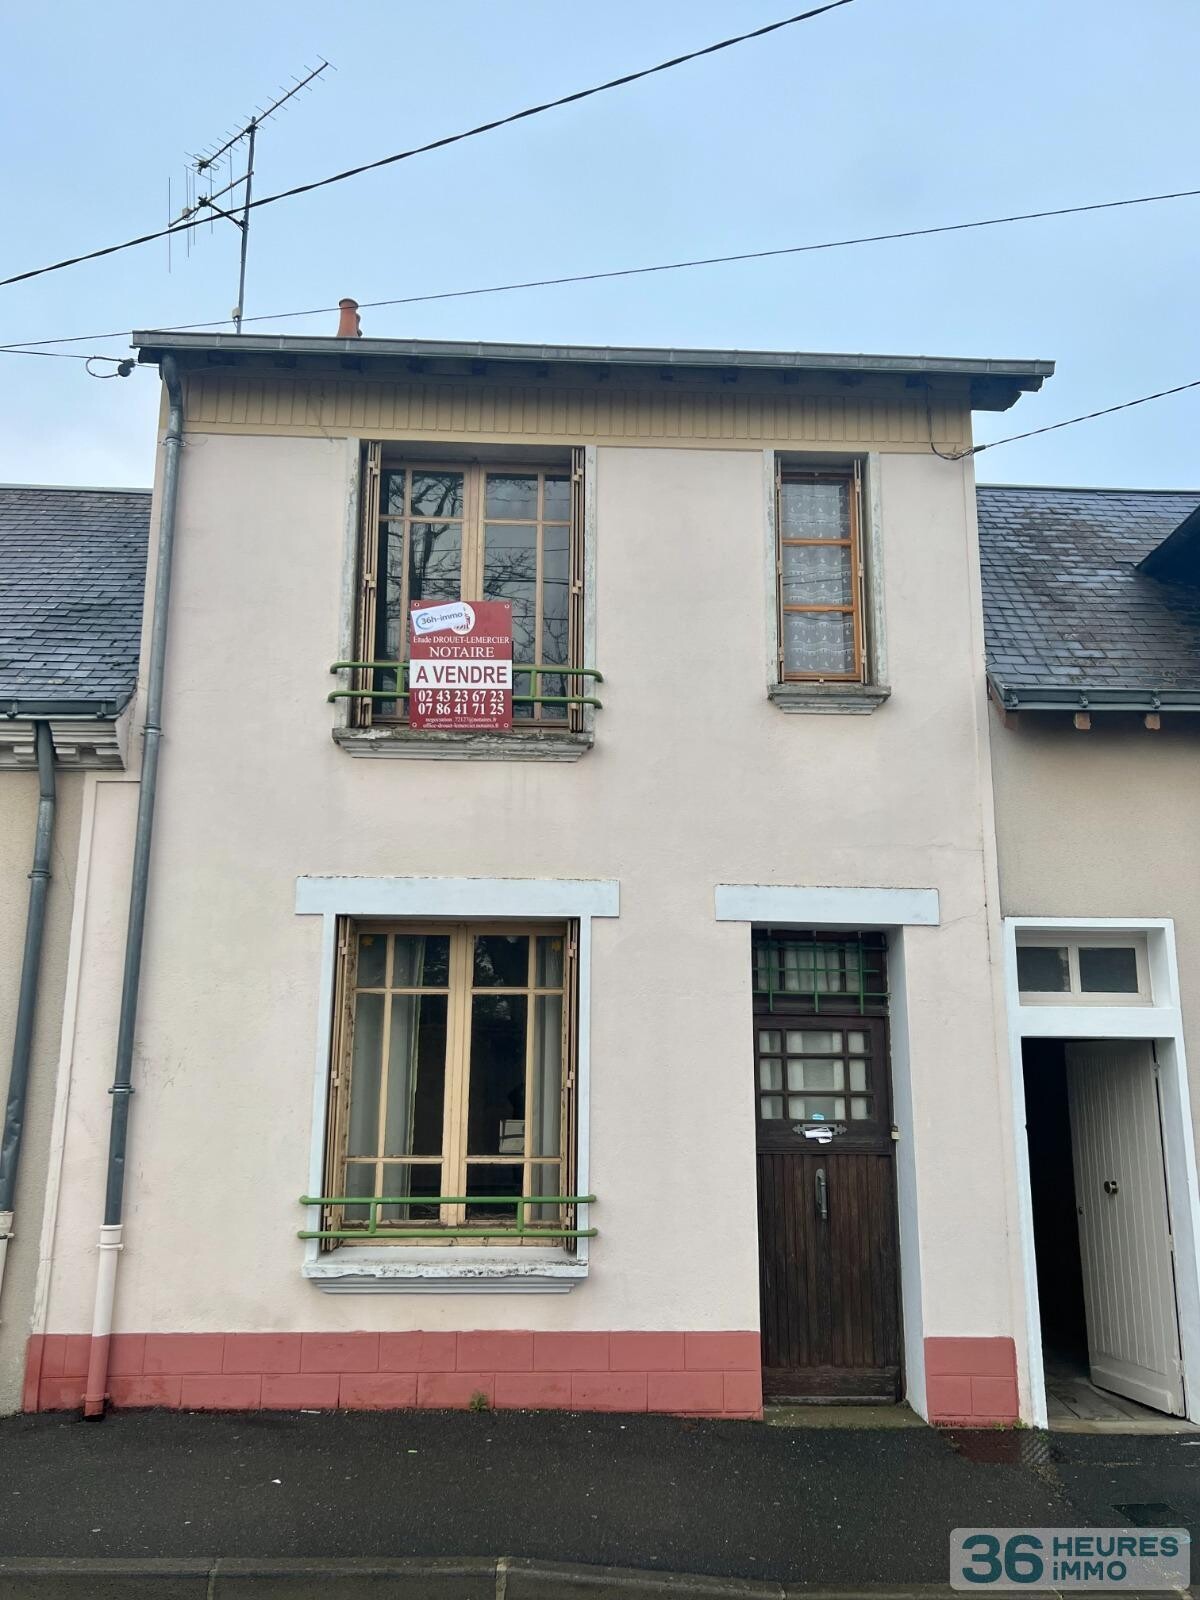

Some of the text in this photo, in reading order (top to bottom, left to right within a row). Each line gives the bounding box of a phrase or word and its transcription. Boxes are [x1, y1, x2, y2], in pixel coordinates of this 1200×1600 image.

[421, 611, 463, 625] 36h-immo
[433, 636, 510, 644] DROUET-LEMERCIER
[429, 646, 495, 658] NOTAIRE
[415, 666, 508, 684] A VENDRE
[418, 690, 504, 702] 02 43 23 67 23
[418, 703, 505, 715] 07 86 41 71 25
